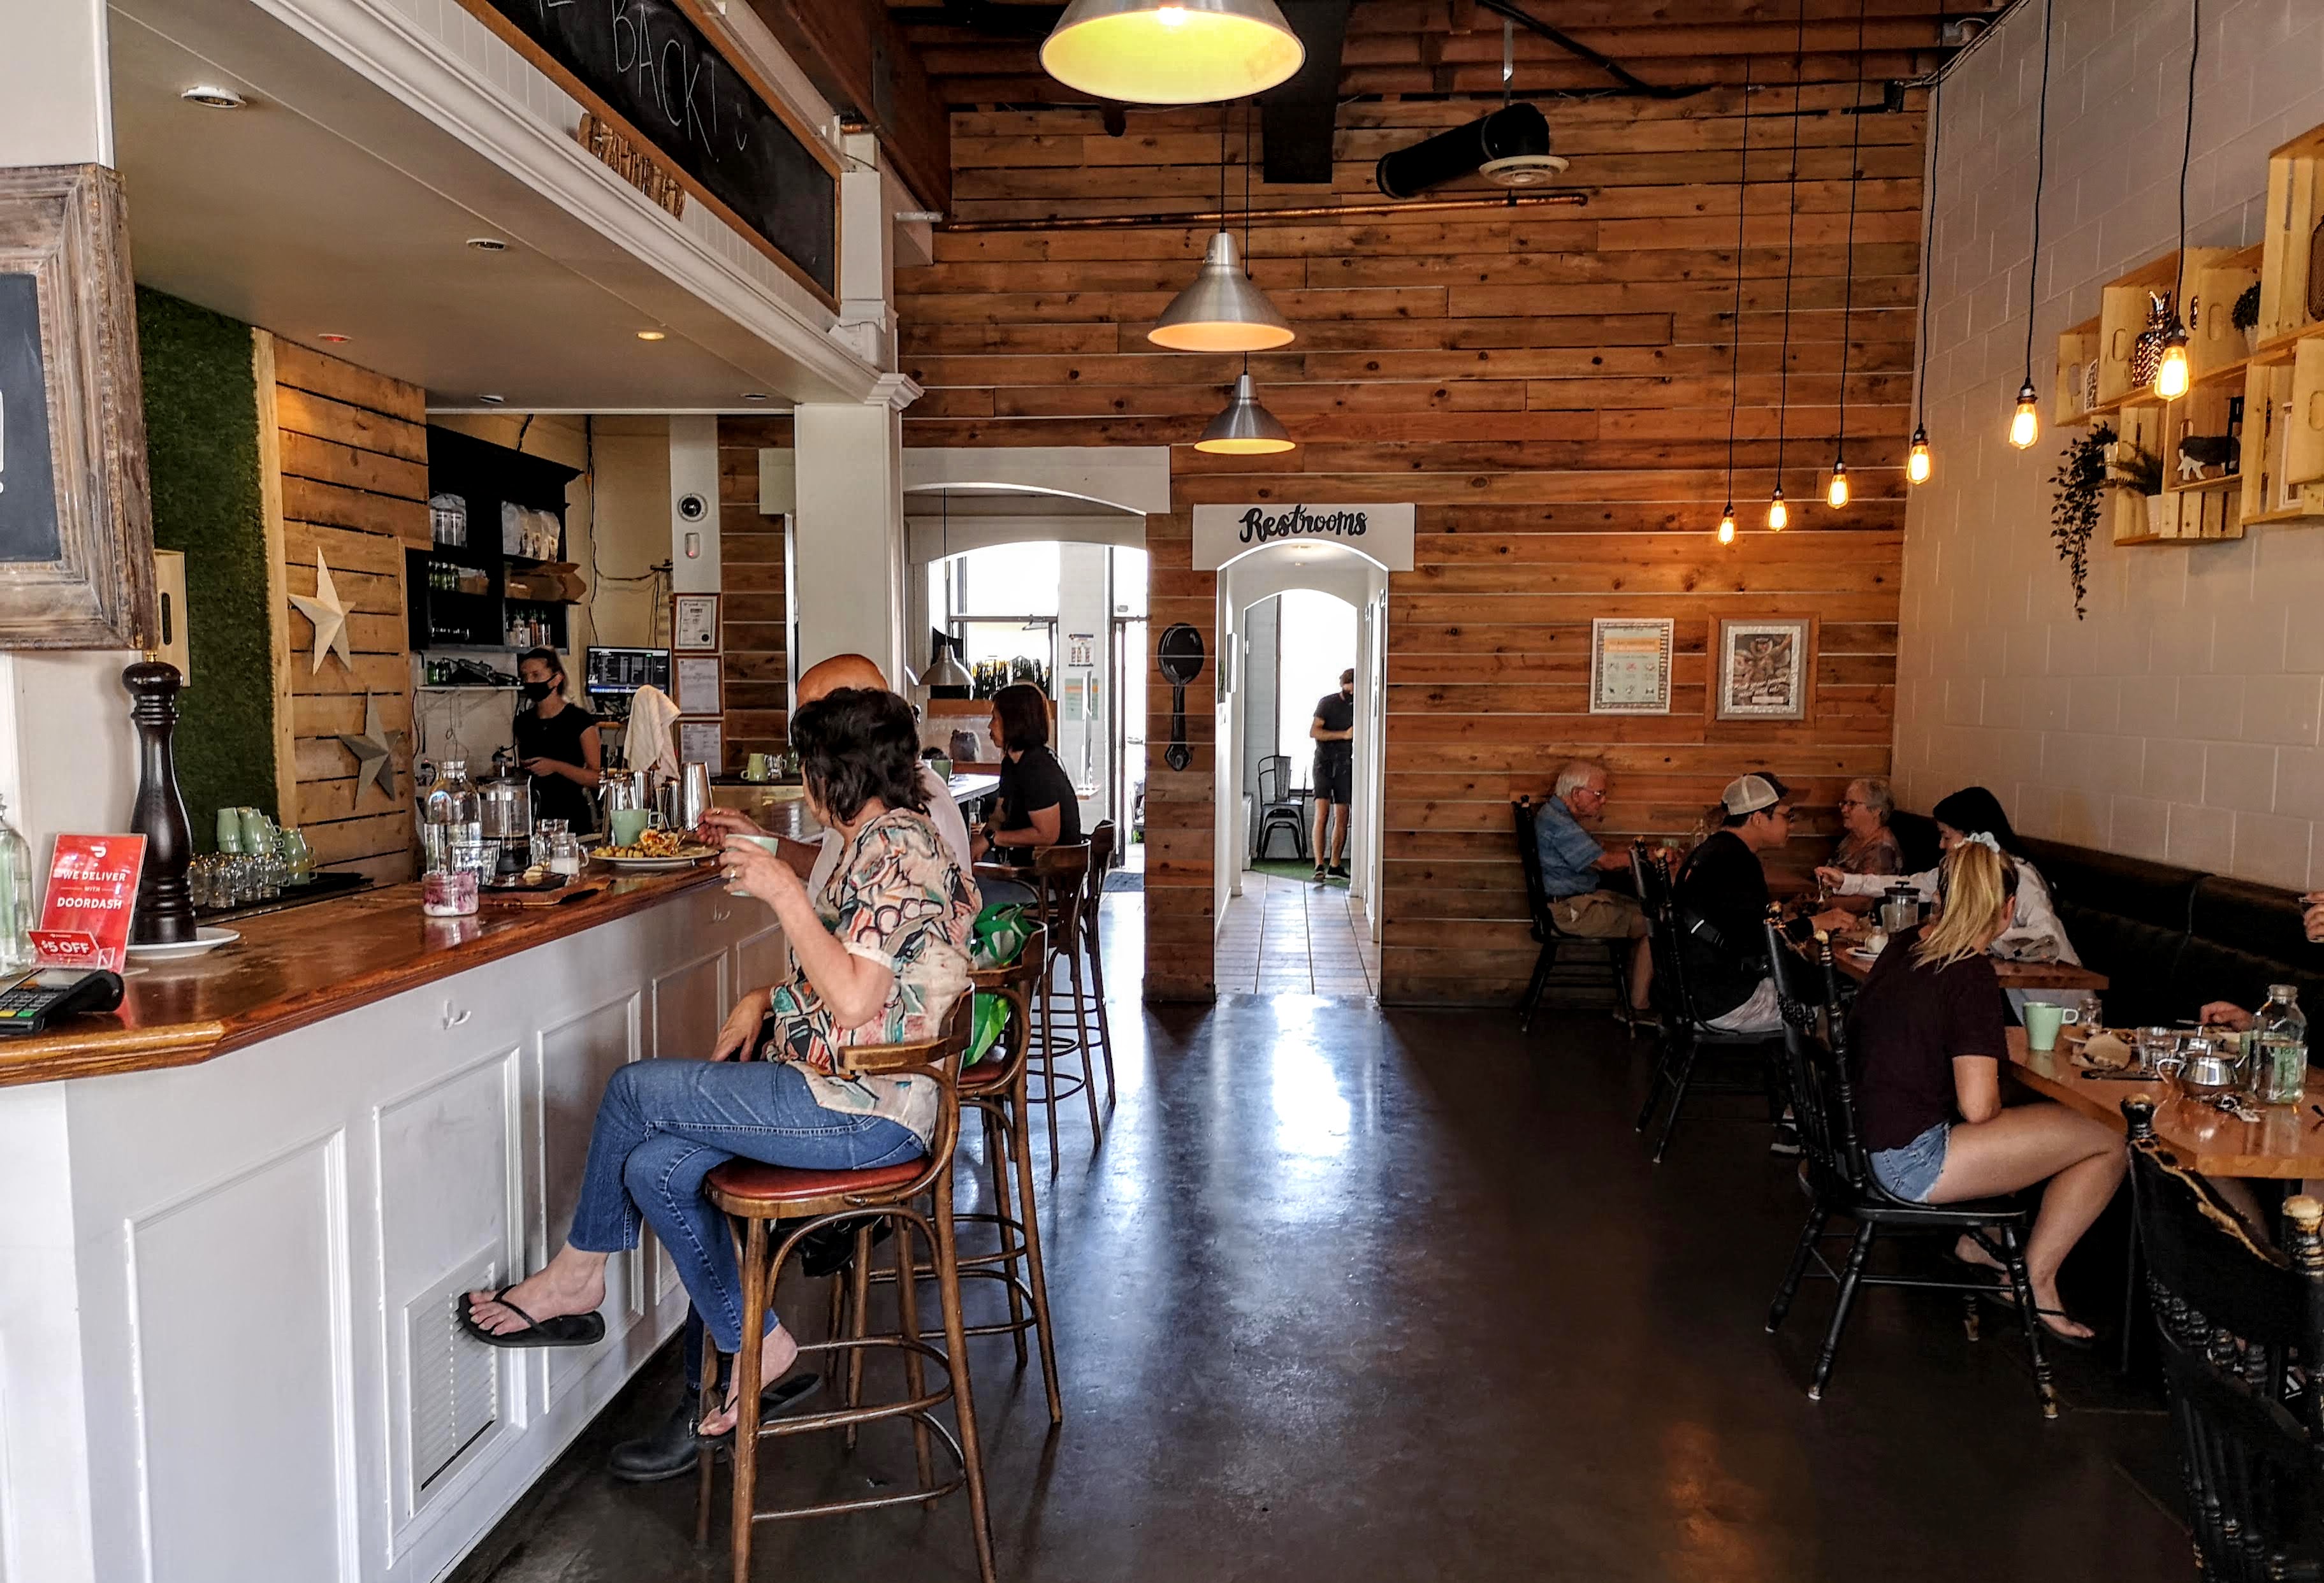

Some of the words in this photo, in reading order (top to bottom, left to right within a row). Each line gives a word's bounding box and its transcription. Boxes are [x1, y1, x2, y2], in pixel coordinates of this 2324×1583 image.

[611, 0, 720, 163] BACK!
[1238, 503, 1368, 543] Restrooms
[64, 871, 79, 880] WE
[82, 871, 126, 882] DELIVER
[57, 897, 123, 910] DOORDASH
[41, 939, 59, 953] $5
[59, 941, 90, 954] OFF
